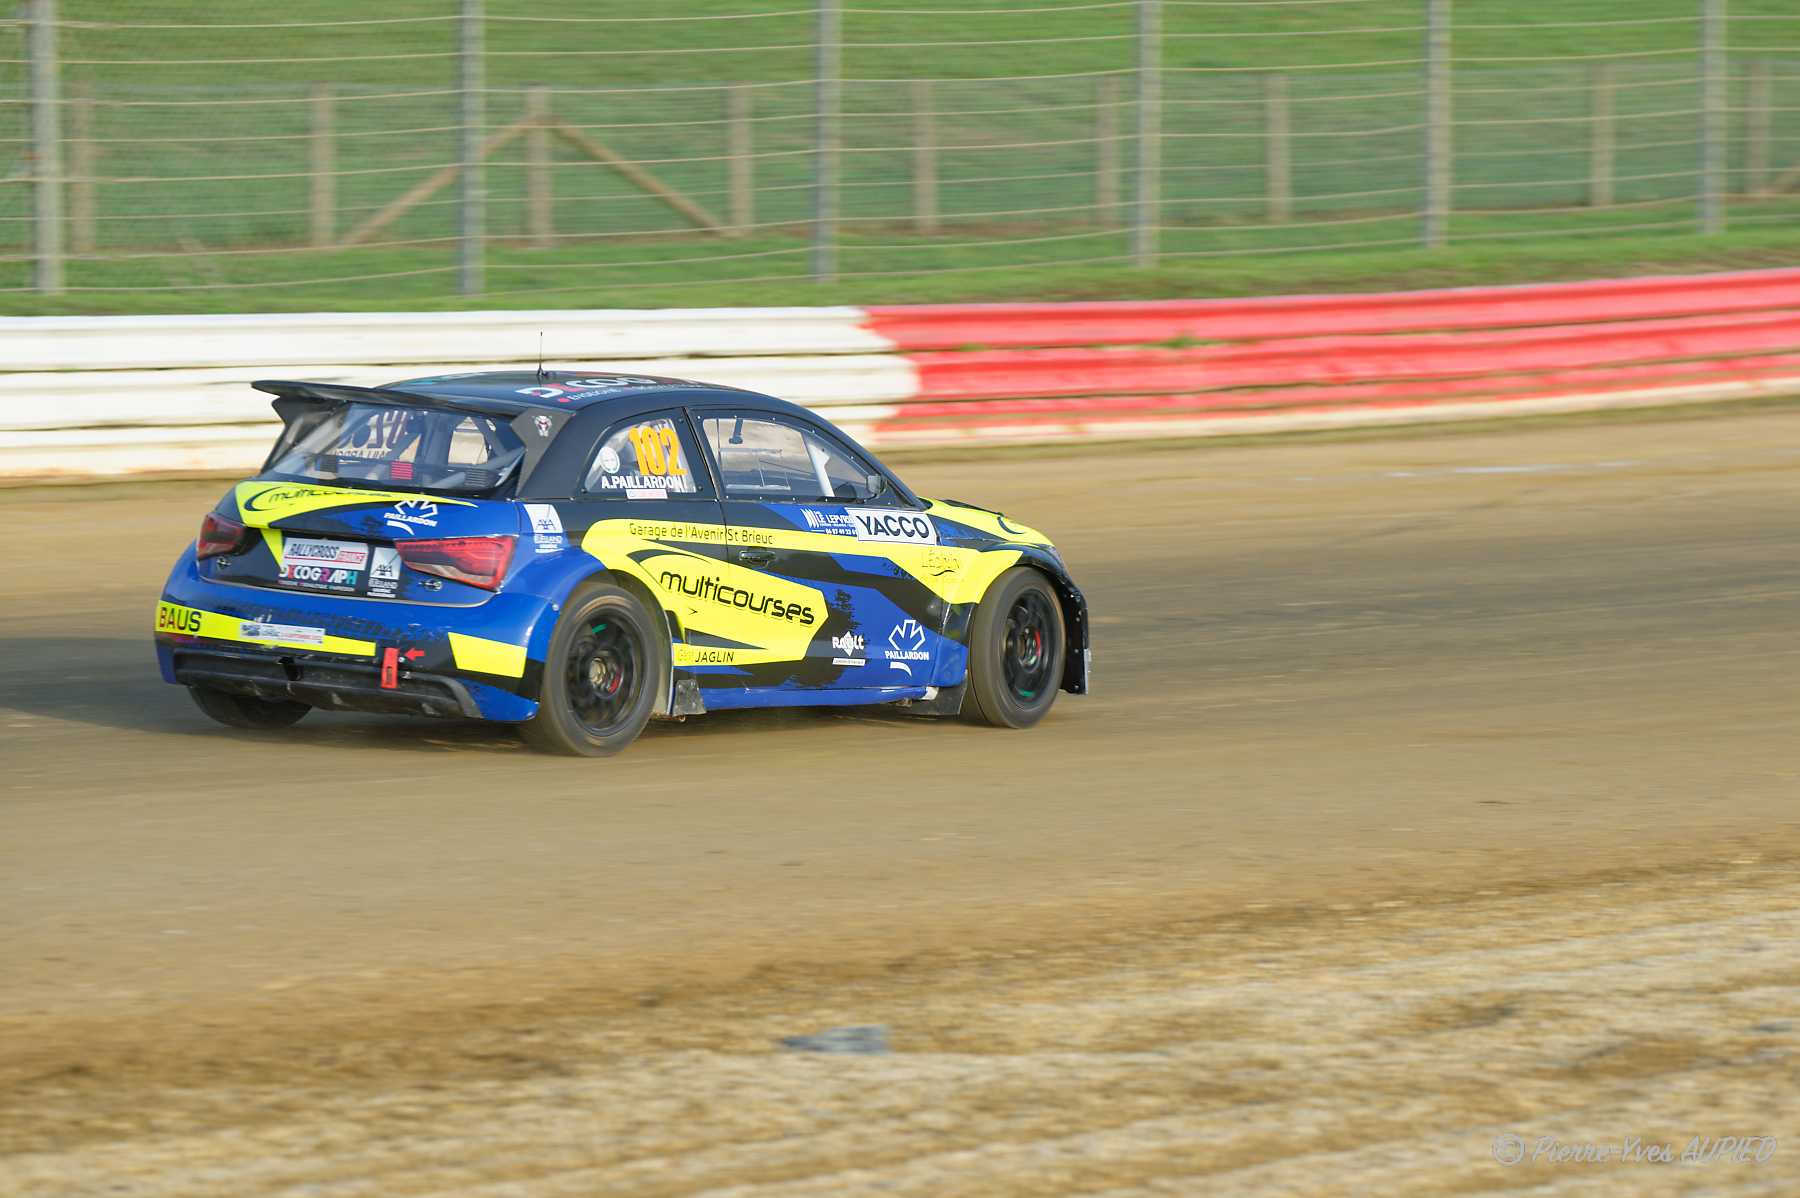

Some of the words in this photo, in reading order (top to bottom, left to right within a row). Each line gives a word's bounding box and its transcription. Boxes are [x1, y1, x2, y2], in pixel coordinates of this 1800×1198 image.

[628, 427, 688, 476] 102
[629, 523, 668, 539] Garage
[670, 527, 684, 538] de
[685, 527, 724, 540] l'Avenir
[727, 528, 739, 541] St
[742, 530, 773, 545] Brieuc
[856, 515, 930, 539] YACCO
[288, 543, 339, 559] RALLYCROSS
[660, 571, 815, 625] multicourses
[159, 607, 202, 633] BAUS
[695, 651, 735, 663] JAGLIN
[885, 650, 930, 661] PAILLARDON
